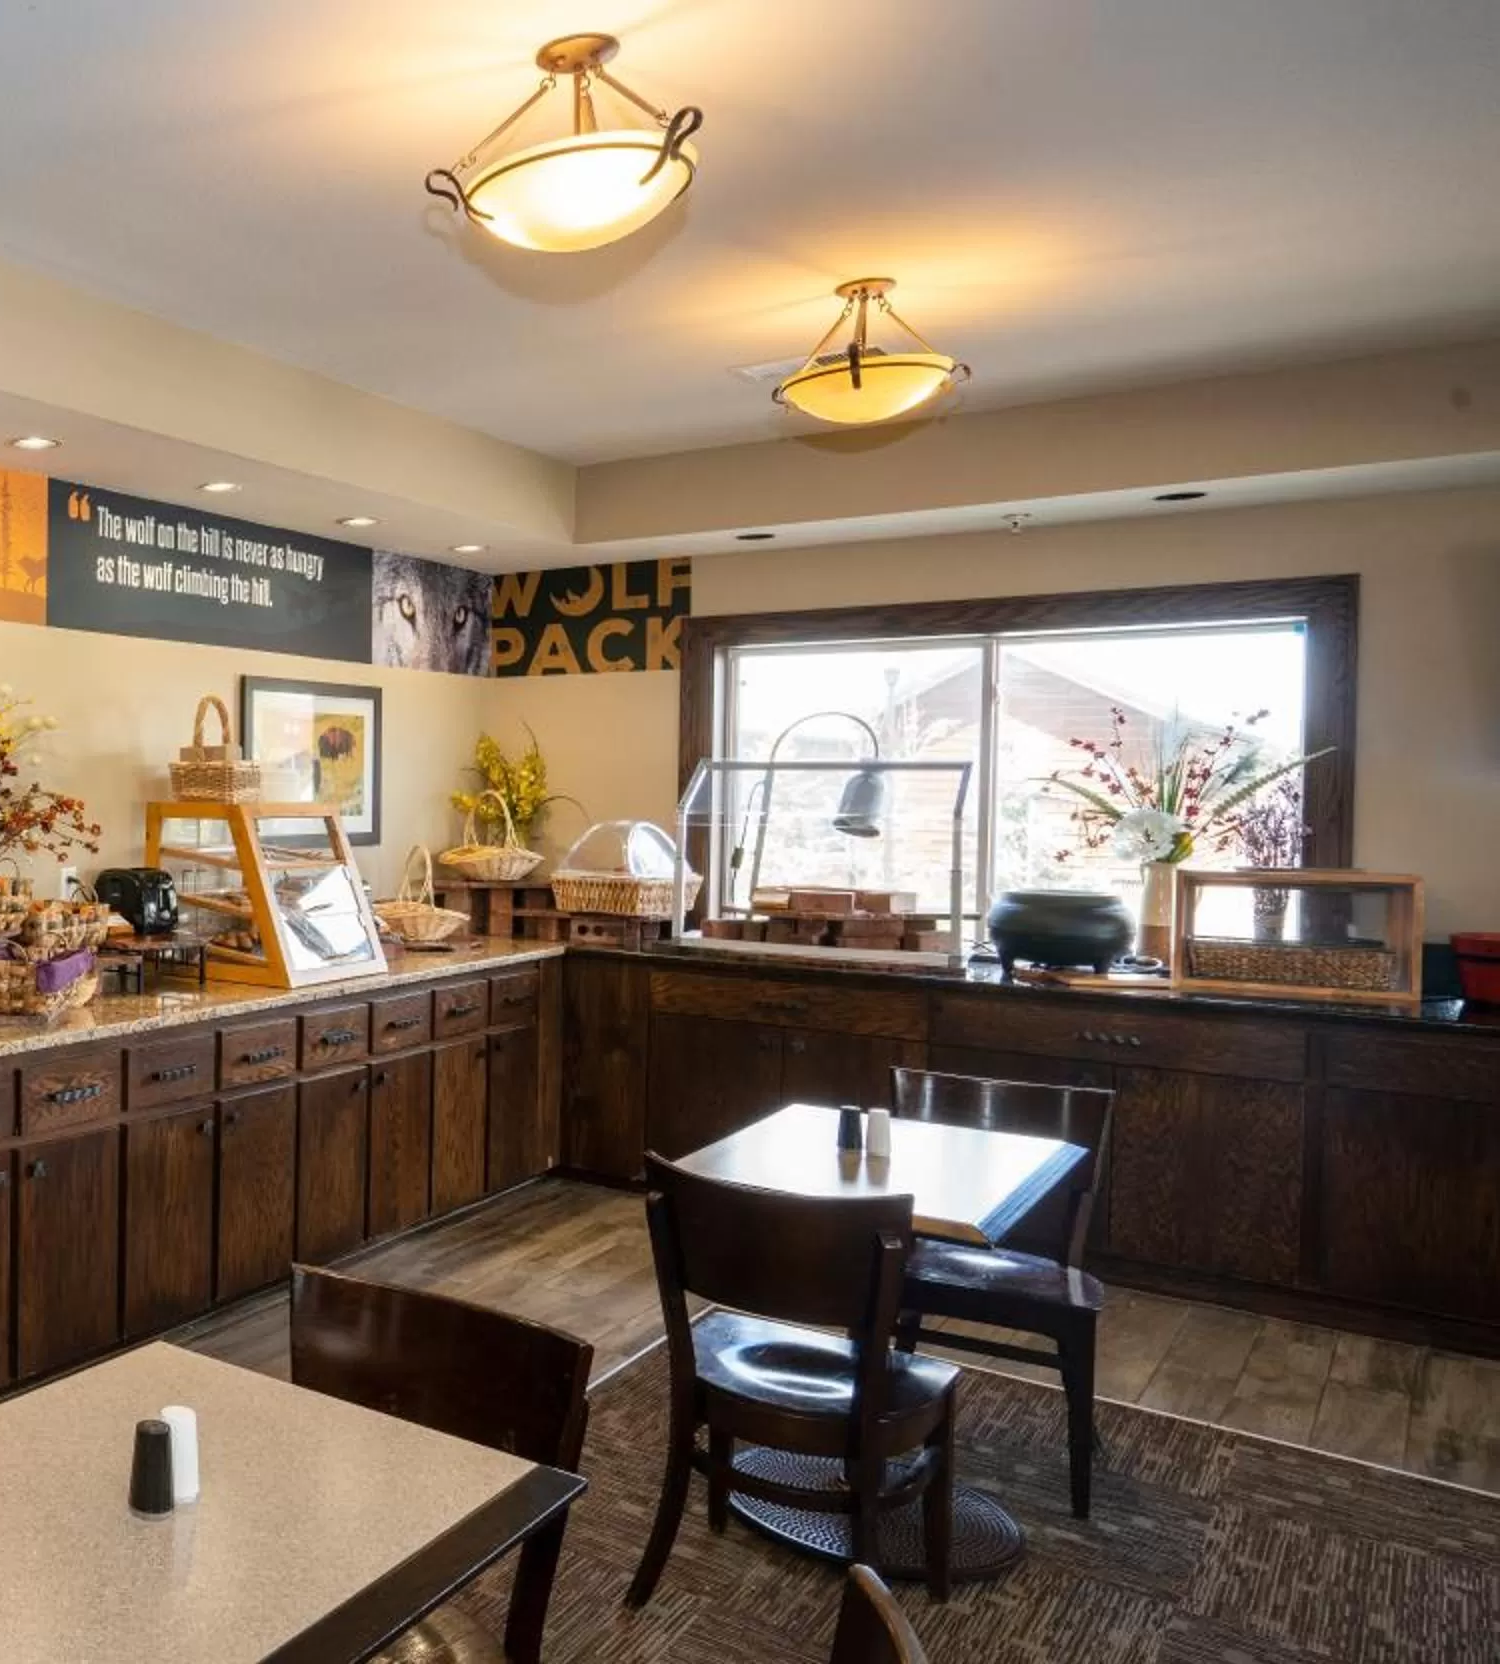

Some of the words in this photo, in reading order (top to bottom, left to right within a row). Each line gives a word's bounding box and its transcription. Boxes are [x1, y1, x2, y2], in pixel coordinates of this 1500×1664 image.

[97, 505, 121, 541] The
[125, 515, 155, 546] wolf
[157, 523, 174, 549] on
[177, 521, 198, 553] the
[201, 524, 220, 557] hill
[222, 530, 234, 560] is
[235, 537, 268, 567] never
[269, 545, 284, 570] as
[285, 543, 324, 582] hungry
[97, 556, 115, 584] as
[118, 555, 140, 588] the
[143, 561, 173, 593] wolf
[175, 564, 229, 605] climbing
[230, 573, 250, 603] the
[251, 576, 273, 608] hill.
[488, 615, 682, 676] PACK
